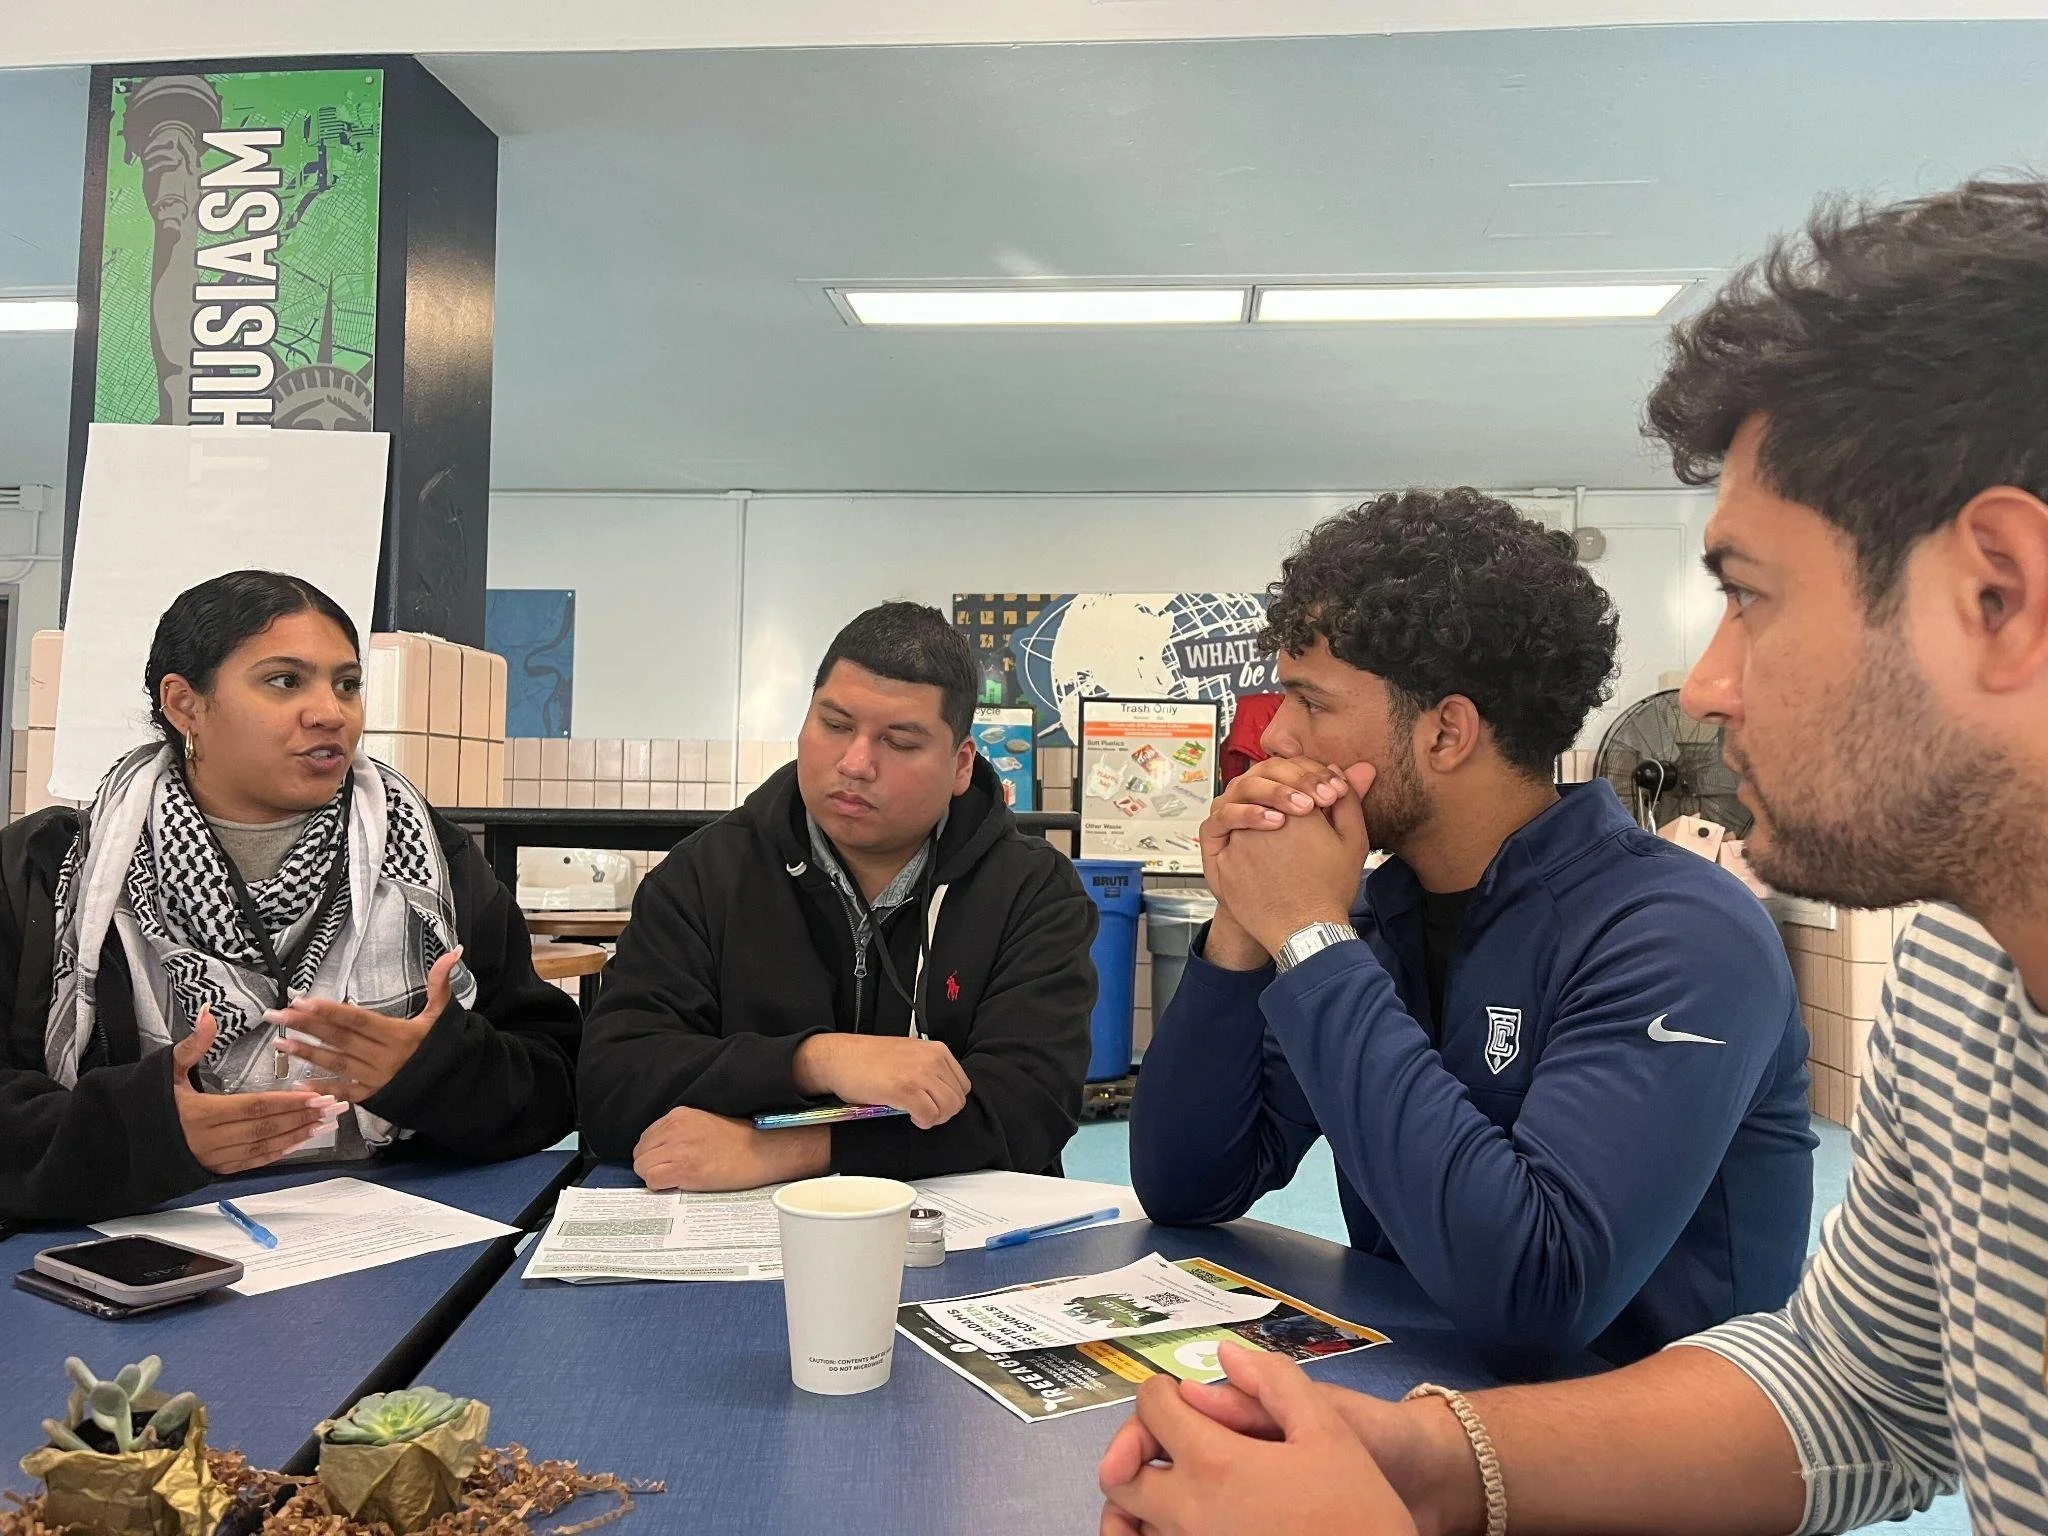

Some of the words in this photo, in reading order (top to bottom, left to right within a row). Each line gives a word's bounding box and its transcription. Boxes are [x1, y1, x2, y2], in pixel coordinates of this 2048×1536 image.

[1238, 661, 1266, 688] be
[1121, 703, 1150, 713] Trash
[1154, 703, 1178, 715] Only
[1092, 875, 1129, 887] BRUTE
[945, 1308, 987, 1332] ADAMS
[981, 1304, 1038, 1331] SCHOOLS!
[996, 1327, 1017, 1335] IN
[981, 1331, 1019, 1349] MAYOR
[809, 1357, 836, 1365] CAUTION:
[837, 1356, 869, 1364] CONTENTS
[1081, 1366, 1101, 1376] New
[984, 1352, 1073, 1408] TREEAGE
